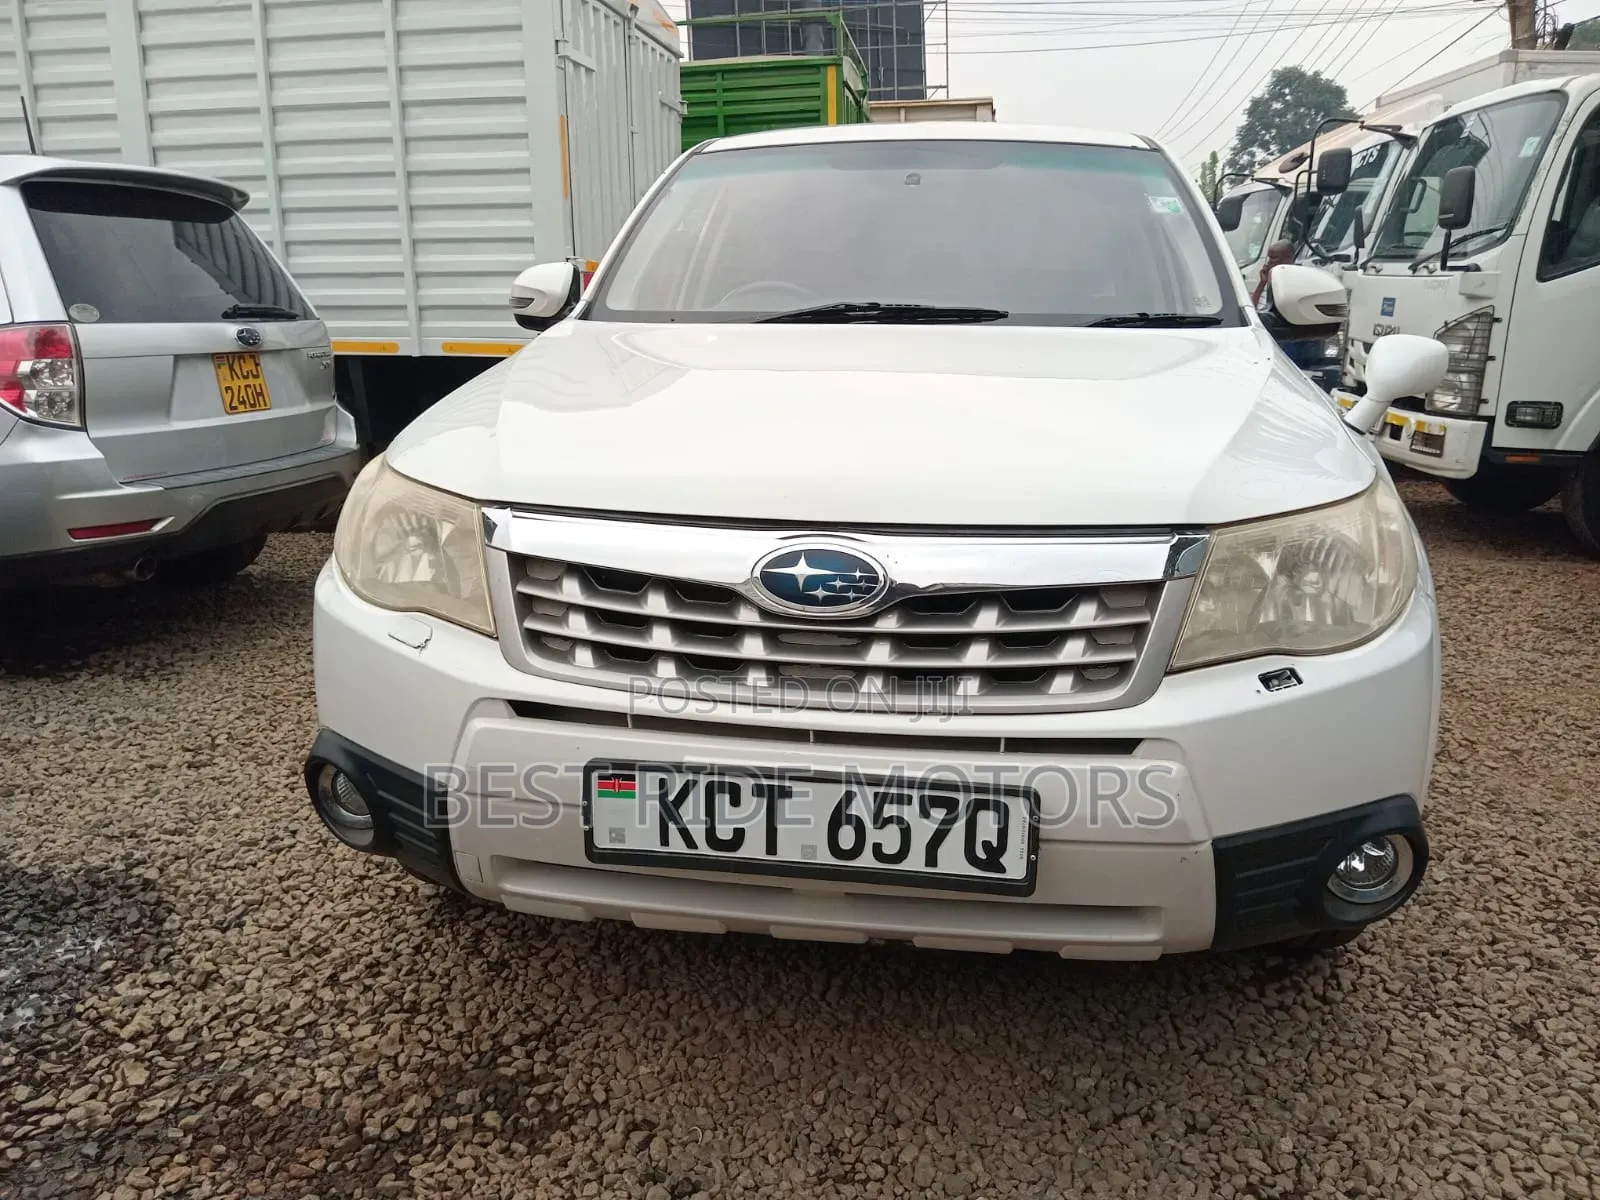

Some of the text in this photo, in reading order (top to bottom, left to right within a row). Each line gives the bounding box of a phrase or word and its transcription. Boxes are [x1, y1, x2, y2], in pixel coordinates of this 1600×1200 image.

[226, 354, 260, 380] KCJ
[225, 384, 267, 410] 240H
[658, 776, 793, 856] KCT
[827, 789, 1010, 874] 657Q
